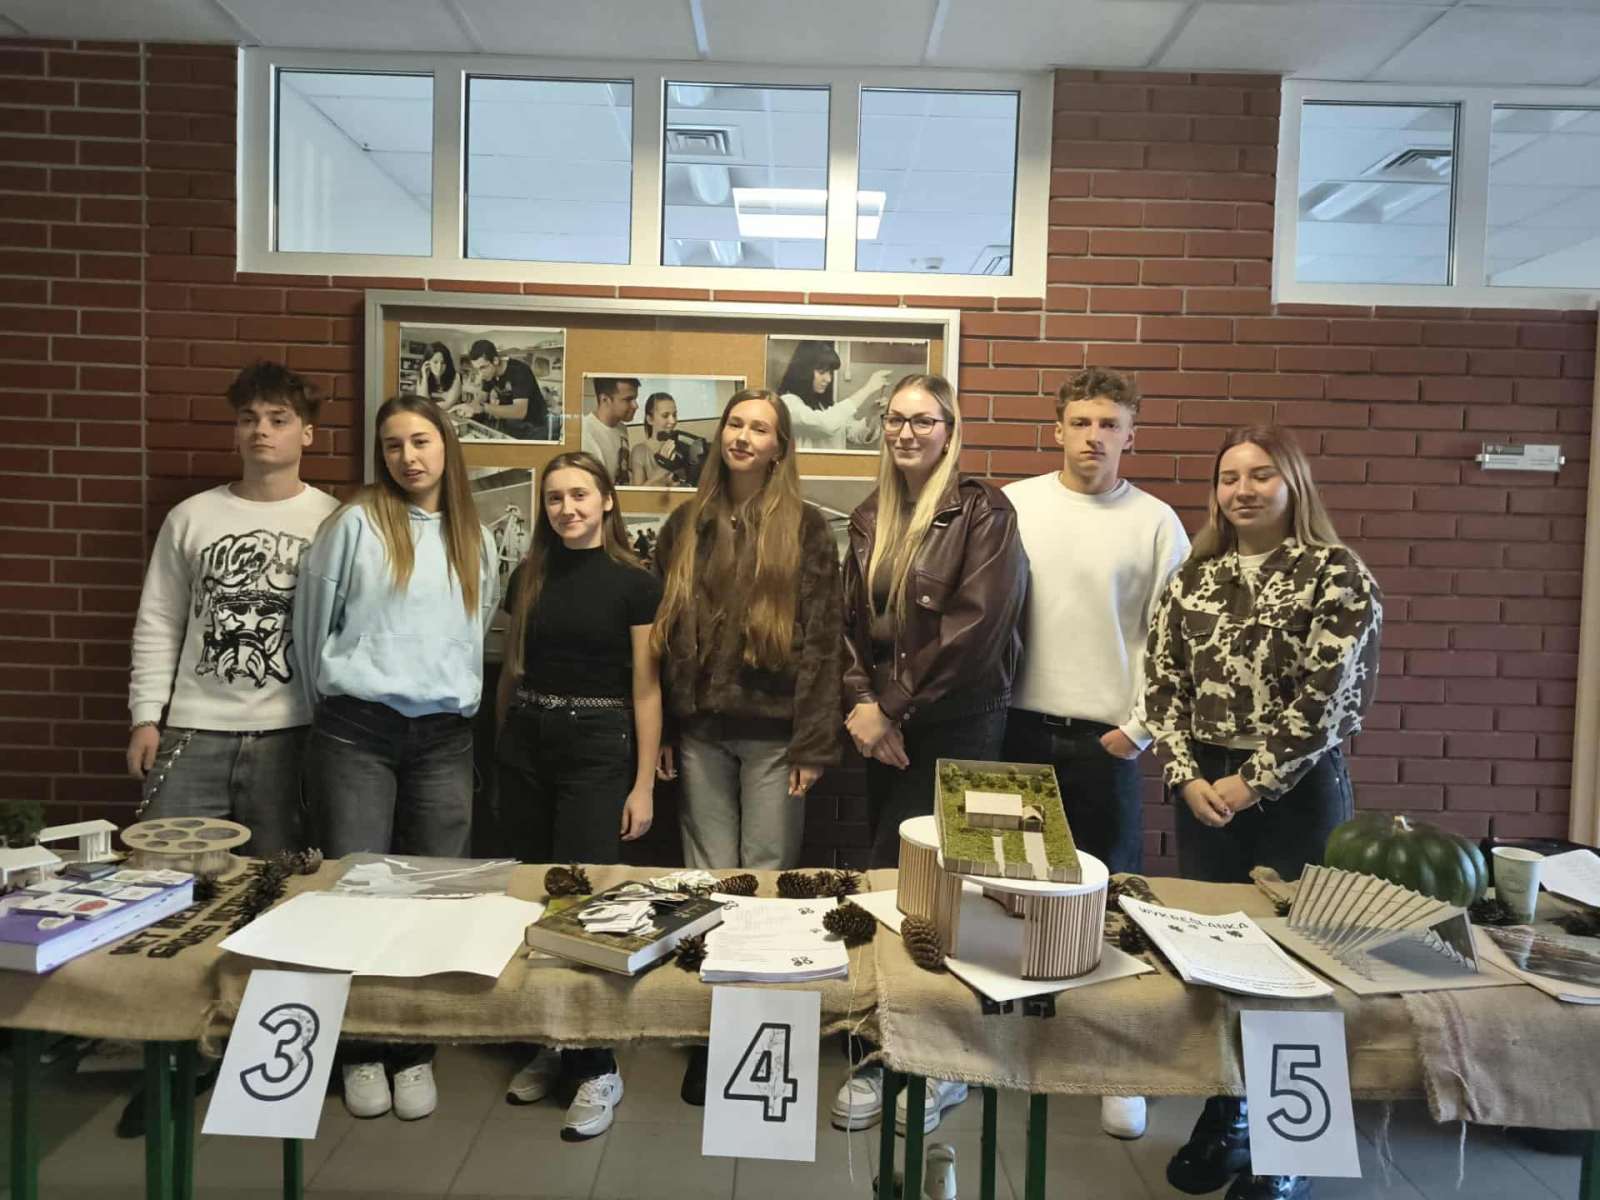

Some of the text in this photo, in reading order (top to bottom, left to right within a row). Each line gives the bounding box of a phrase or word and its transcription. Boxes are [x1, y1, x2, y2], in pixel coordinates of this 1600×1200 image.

[239, 1003, 320, 1102] 3
[723, 1022, 798, 1123] 4
[1267, 1043, 1331, 1142] 5
